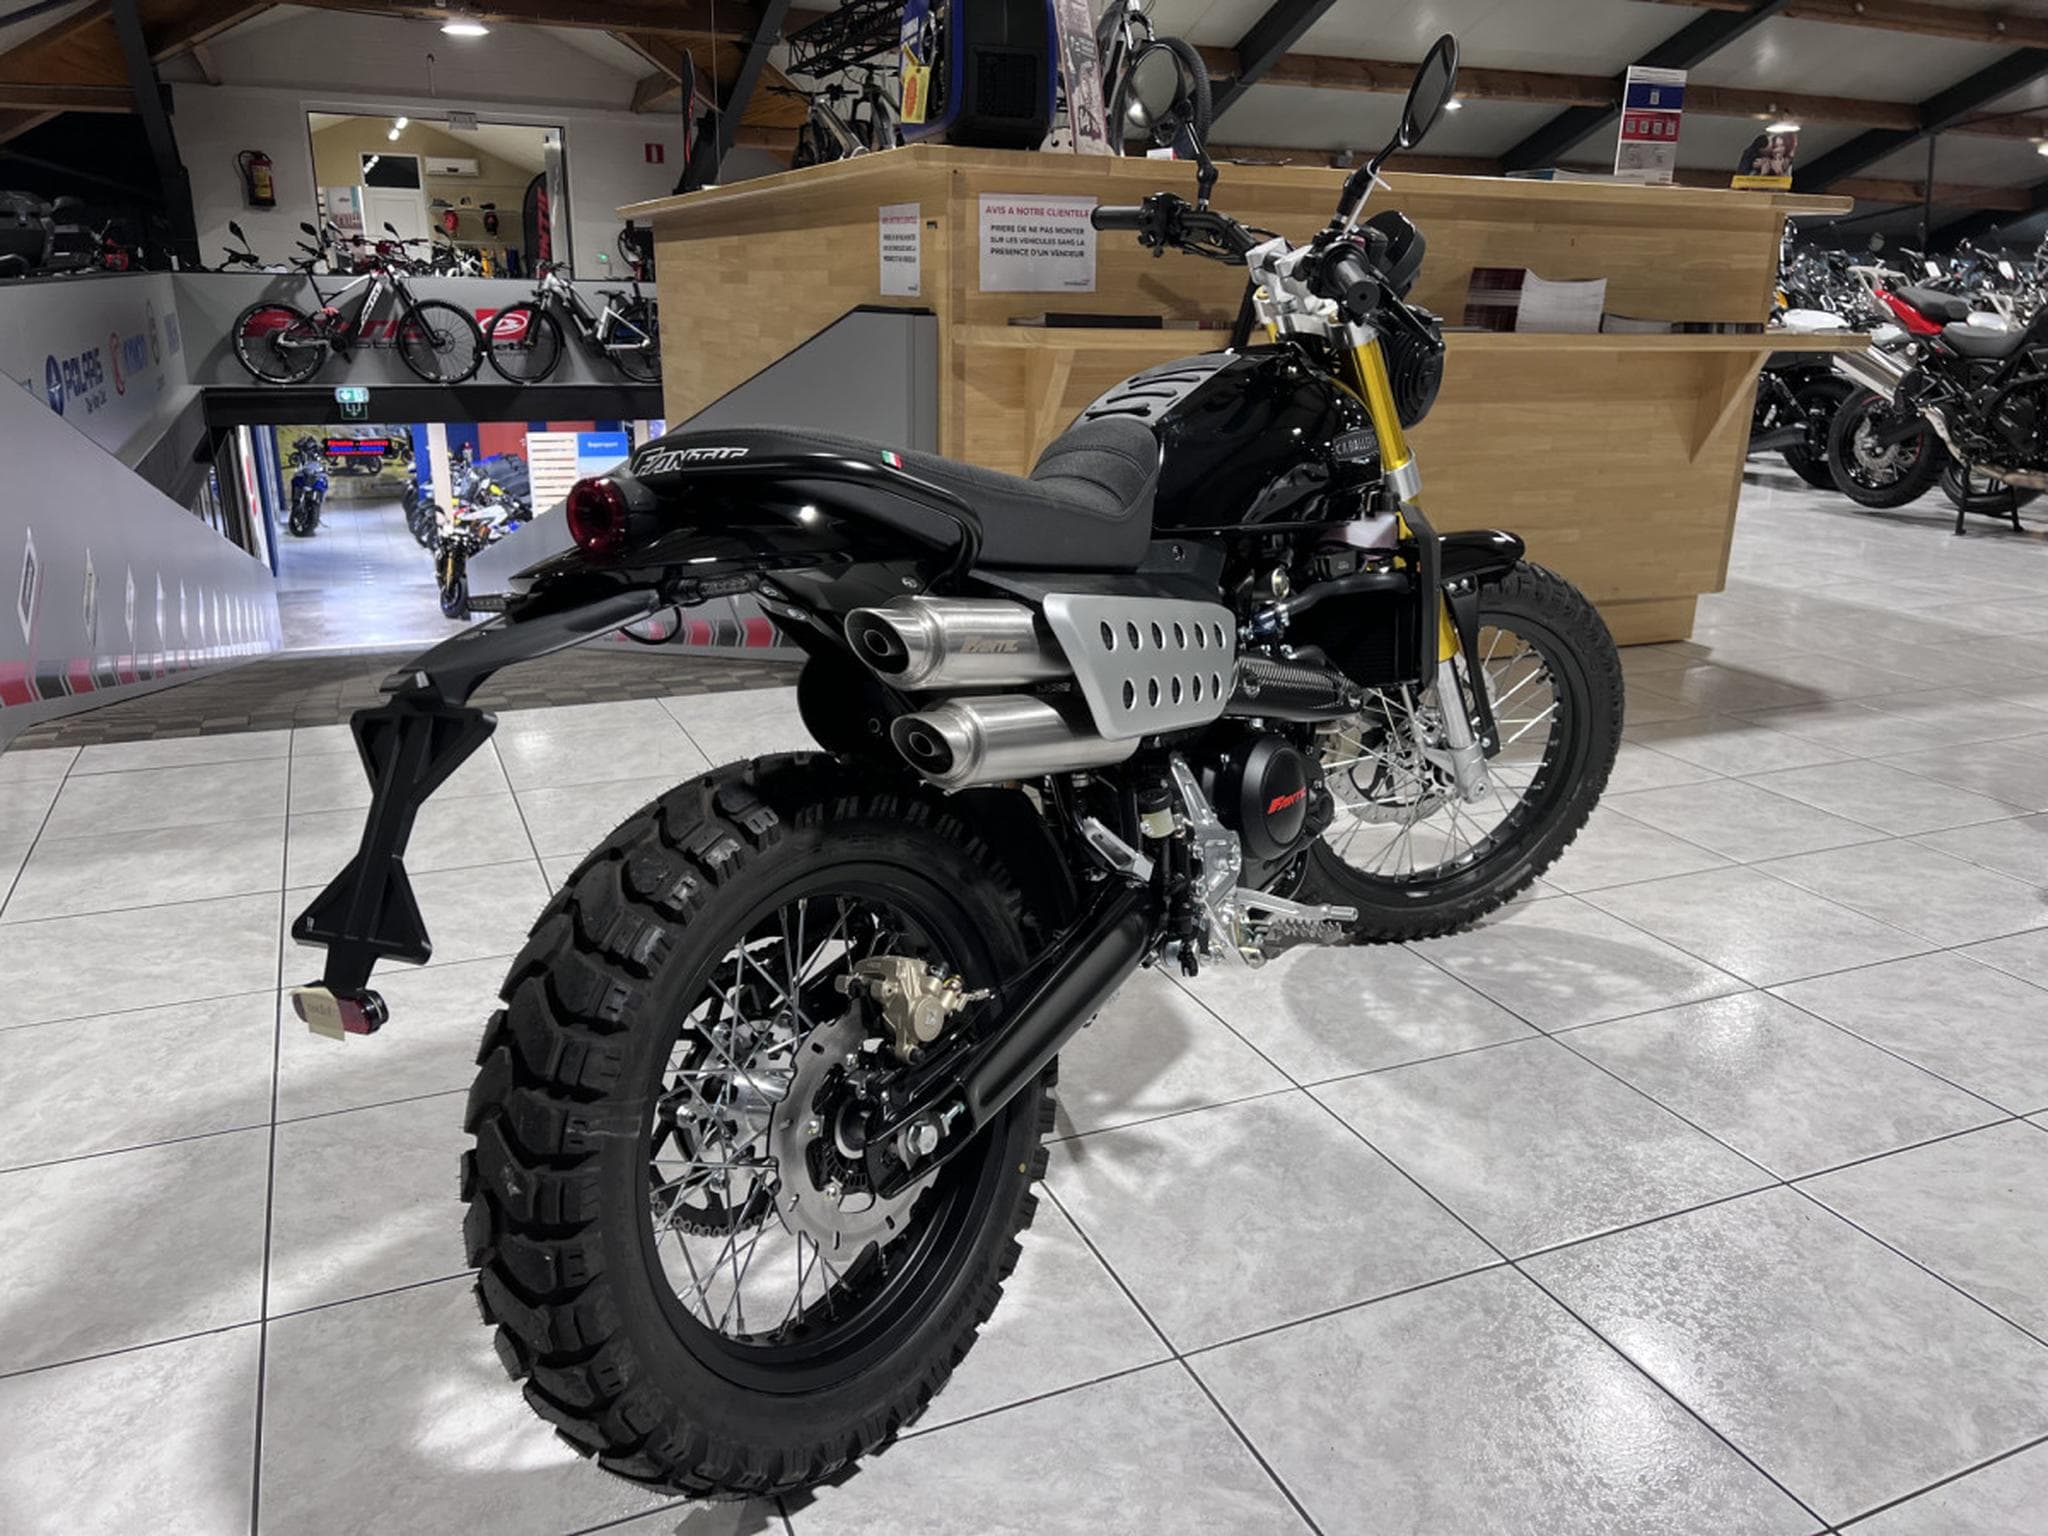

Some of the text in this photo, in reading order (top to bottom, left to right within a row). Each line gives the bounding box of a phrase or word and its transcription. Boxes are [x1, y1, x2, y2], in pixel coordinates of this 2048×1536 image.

[986, 206, 1090, 218] AVIS A NOTRE CLIENTELE
[990, 225, 1084, 235] PRIERE DE NE PAS MONTER
[990, 236, 1004, 244] SUR
[1020, 238, 1056, 246] VEHICULES
[990, 248, 1085, 258] PRESENCE D'UN VENDEUR
